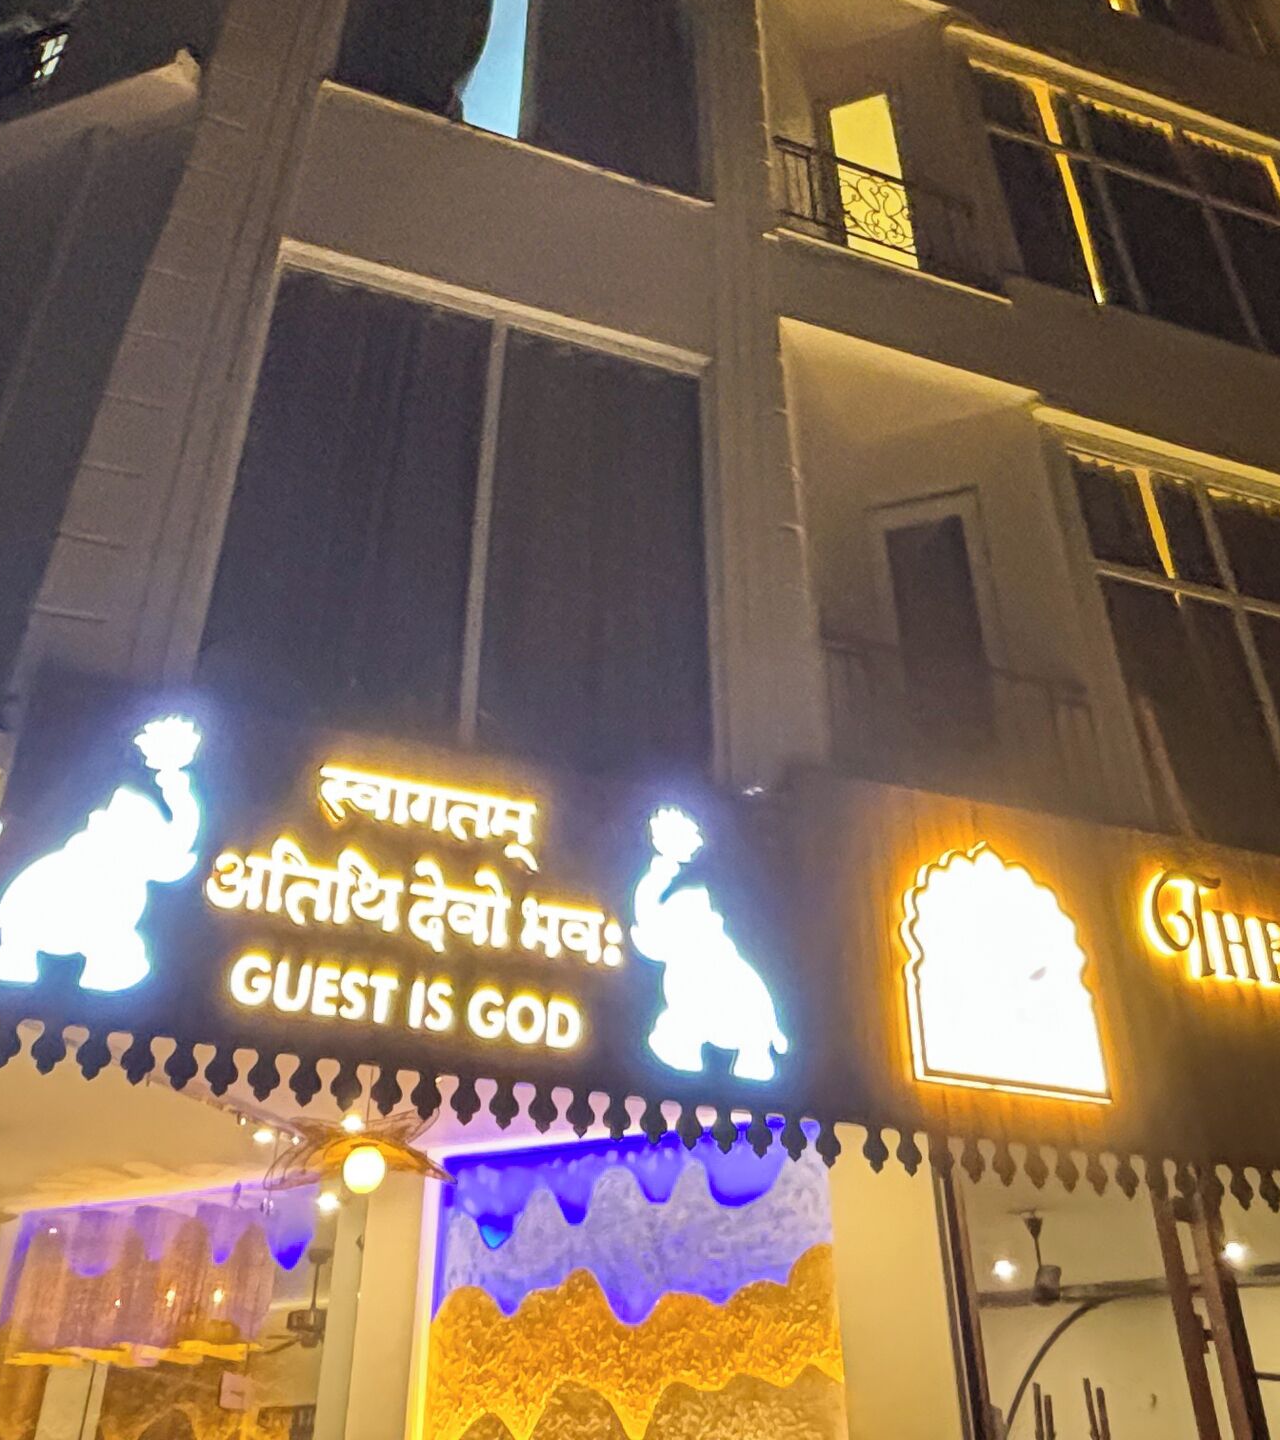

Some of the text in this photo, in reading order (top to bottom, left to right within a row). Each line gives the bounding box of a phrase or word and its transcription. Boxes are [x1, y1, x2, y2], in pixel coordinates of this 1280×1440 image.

[320, 764, 540, 873] स्वागतम्
[206, 836, 405, 933] अतिथि
[407, 859, 512, 953] देवो
[230, 952, 584, 1050] GUEST IS GOD
